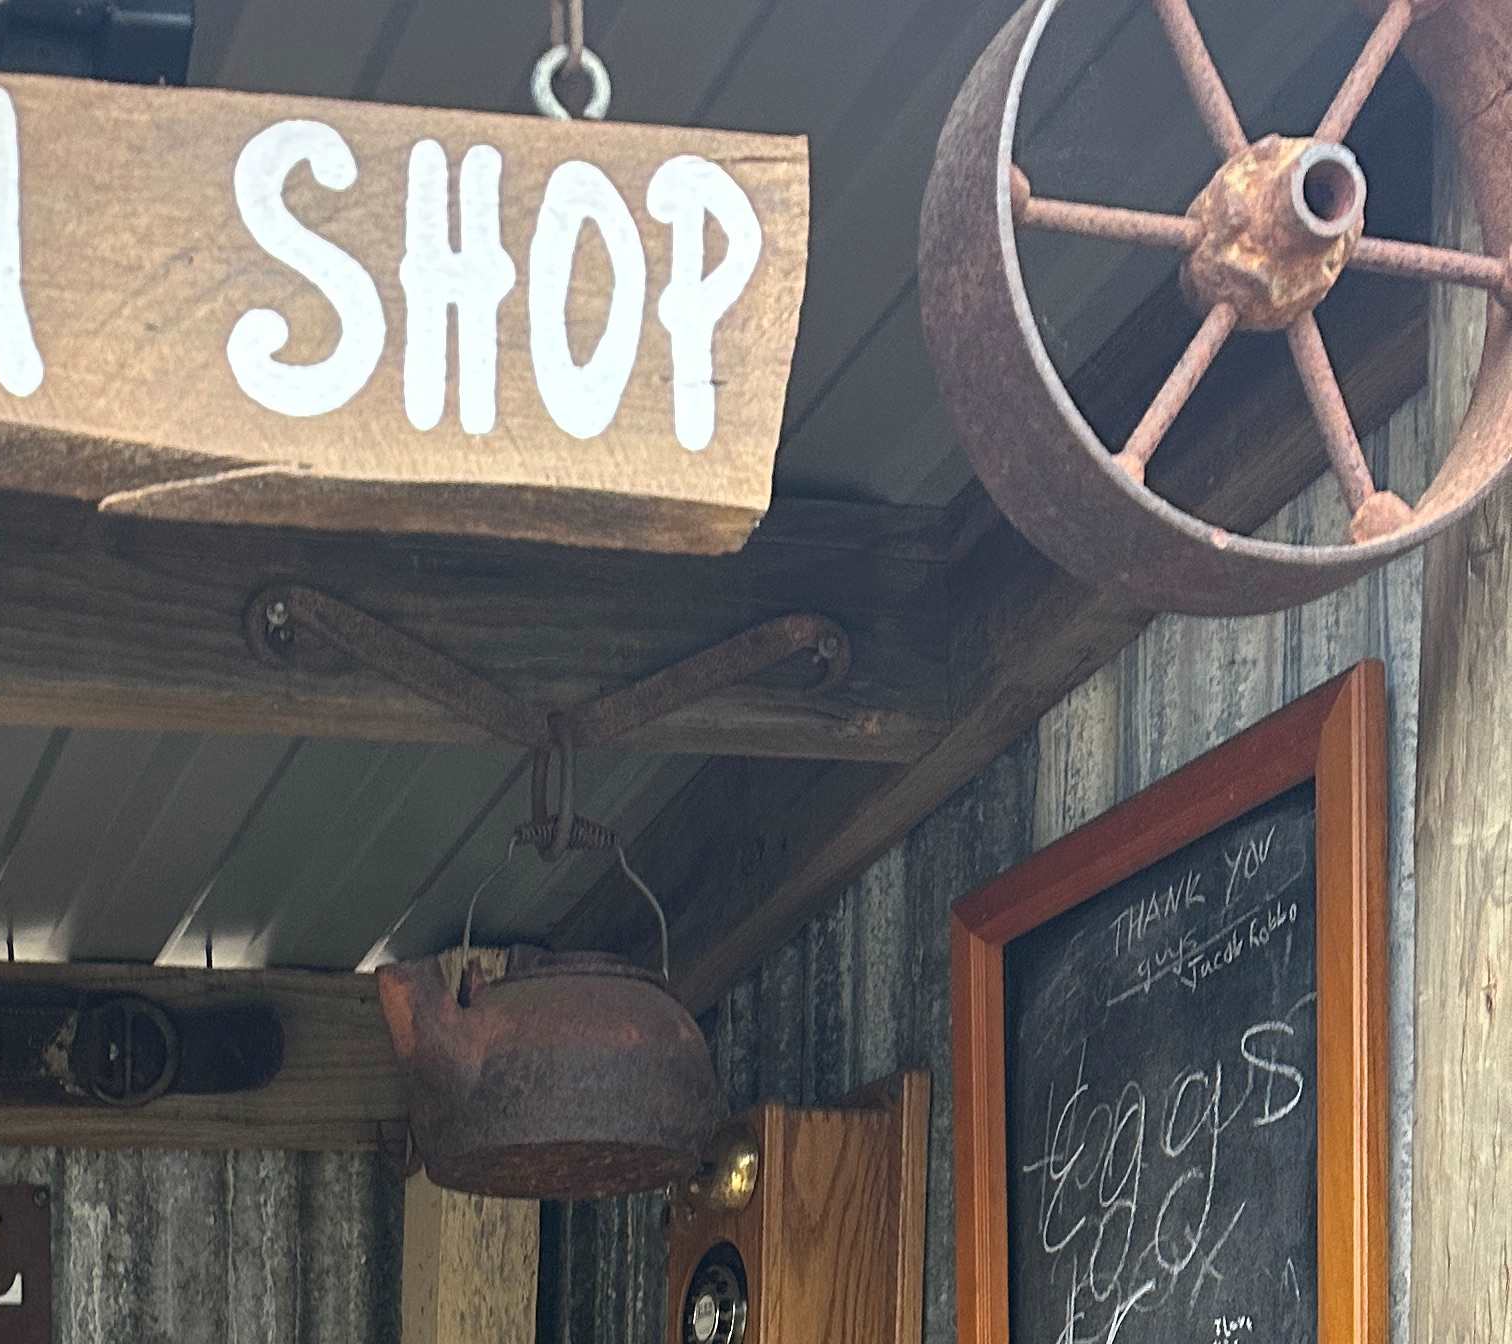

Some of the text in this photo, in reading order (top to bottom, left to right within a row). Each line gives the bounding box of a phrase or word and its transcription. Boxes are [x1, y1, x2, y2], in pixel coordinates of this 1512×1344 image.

[226, 118, 762, 451] SHOP
[1110, 824, 1277, 957] THANK YOU
